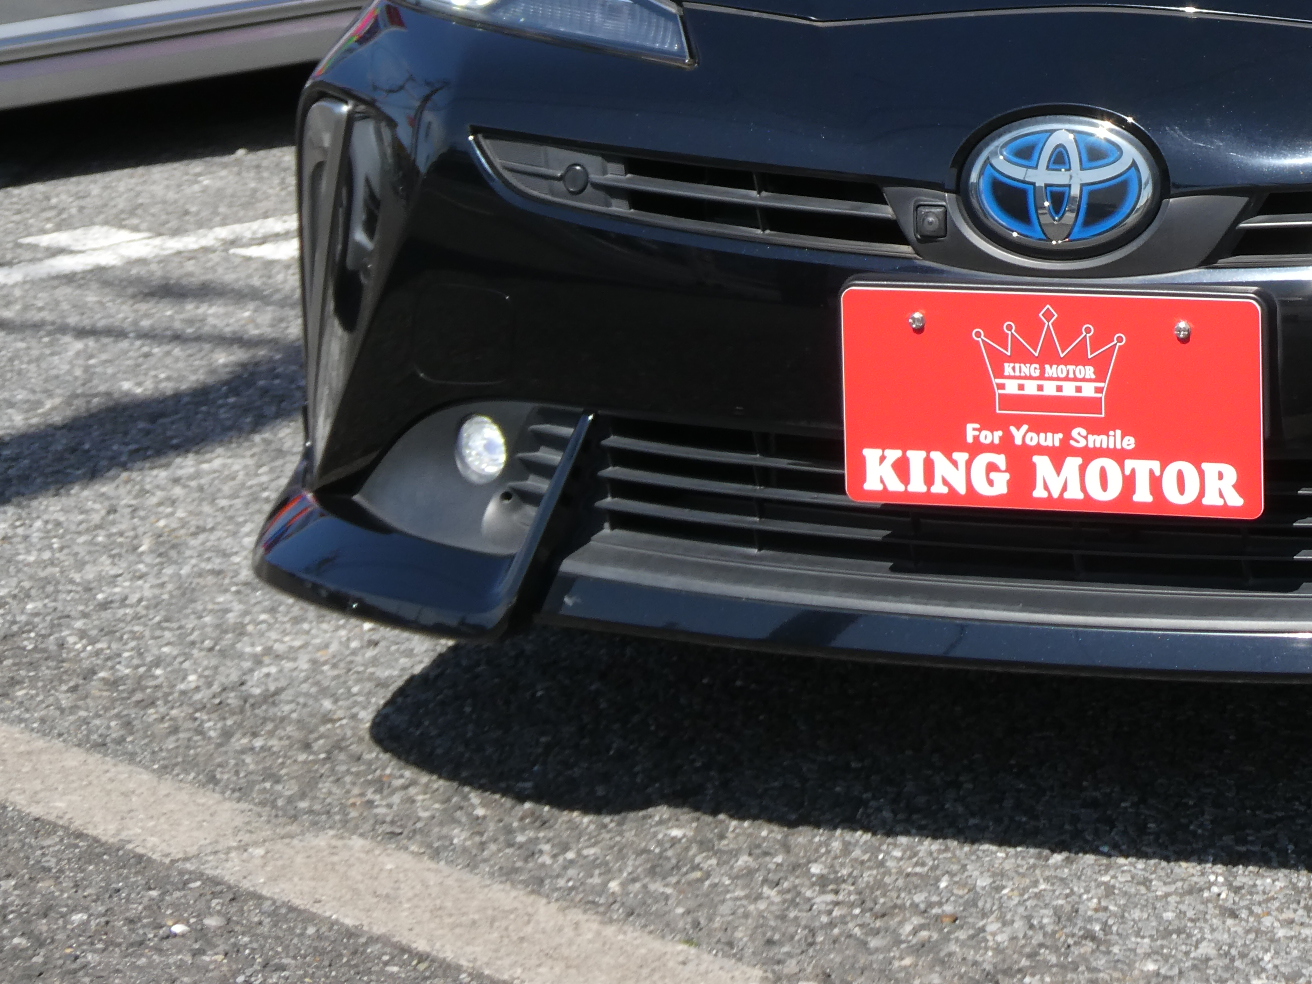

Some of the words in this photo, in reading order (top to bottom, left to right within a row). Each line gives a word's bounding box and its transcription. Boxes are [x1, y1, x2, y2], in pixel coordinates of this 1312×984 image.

[1003, 362, 1040, 377] KING
[1044, 364, 1096, 380] MOTOR
[966, 423, 1003, 445] For
[1009, 425, 1063, 448] Your
[1069, 428, 1136, 450] Smile
[862, 448, 1010, 496] KING
[1032, 455, 1245, 507] MOTOR
